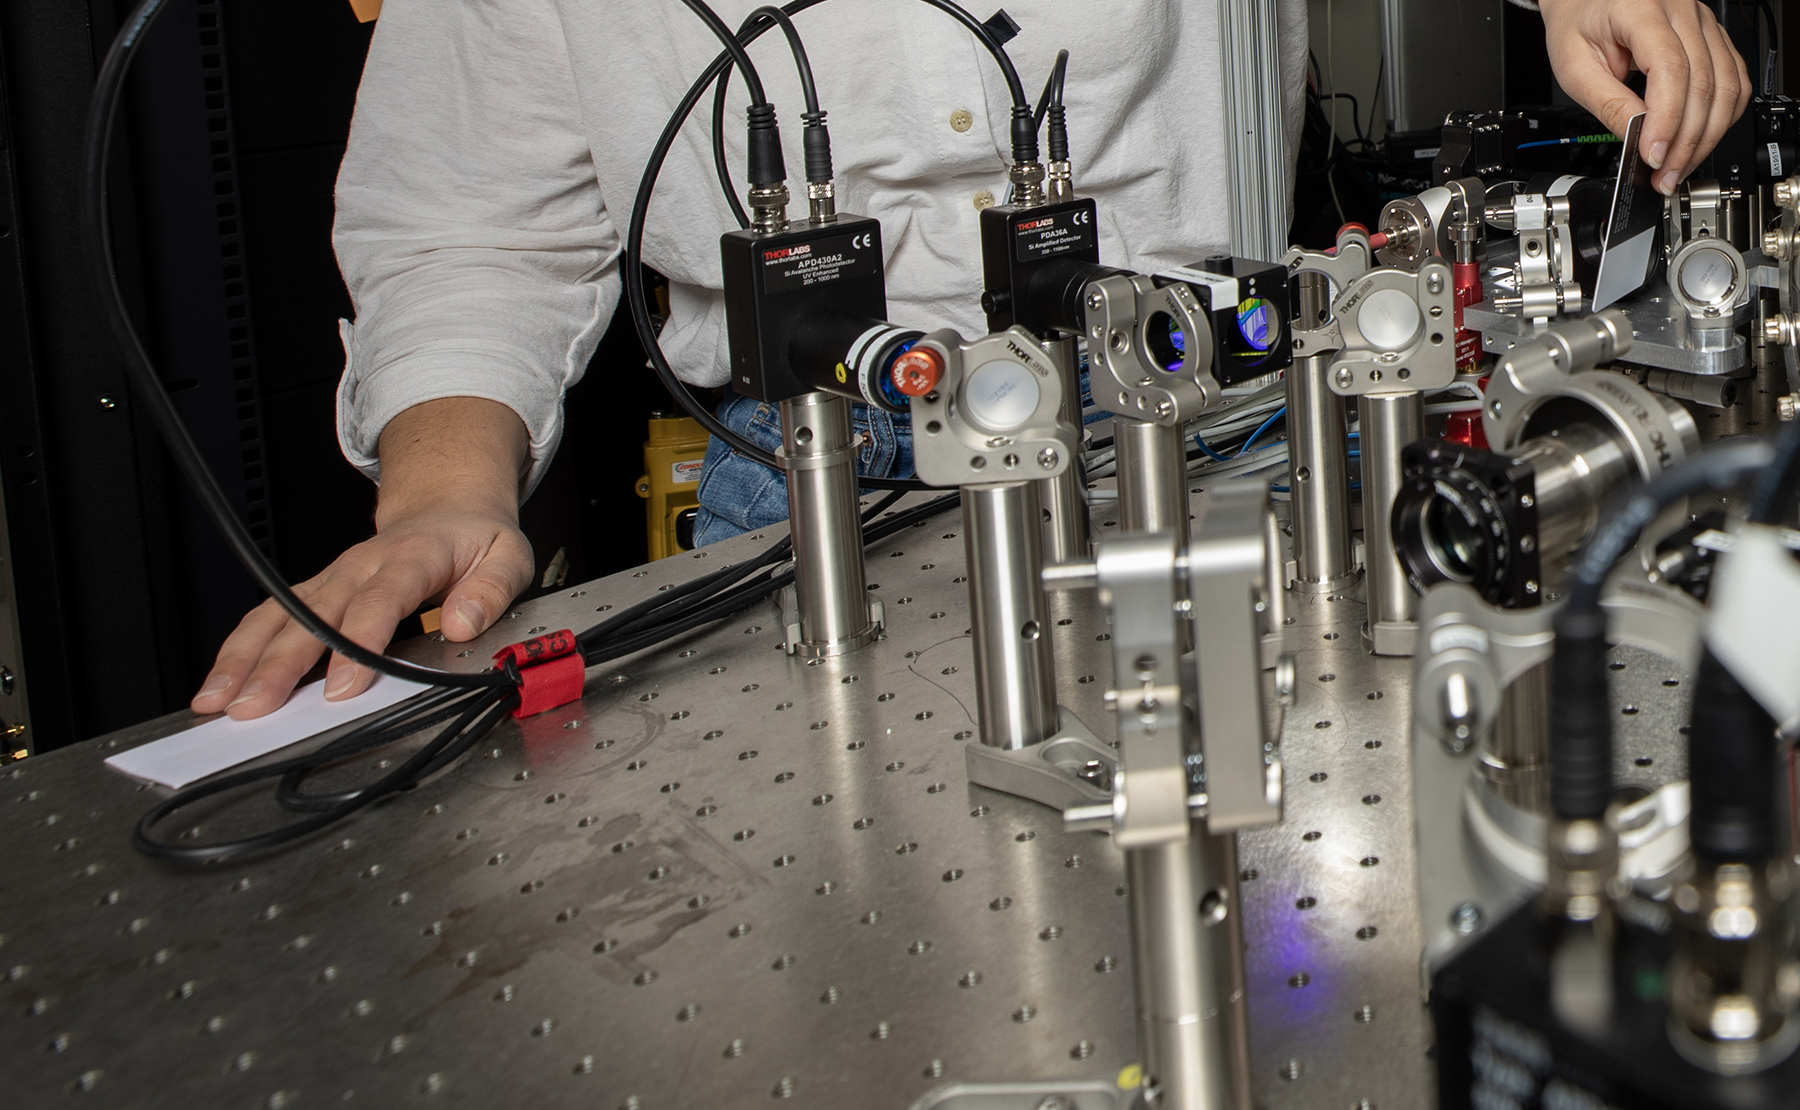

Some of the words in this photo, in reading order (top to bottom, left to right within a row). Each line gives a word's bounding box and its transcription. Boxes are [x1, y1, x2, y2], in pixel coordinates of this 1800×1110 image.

[1769, 144, 1781, 176] LA1951-B
[1017, 218, 1054, 231] THORLABS
[1040, 228, 1068, 239] PDA36A
[1035, 239, 1059, 249] Amplified
[1060, 235, 1081, 244] Detector
[764, 245, 811, 260] THORLABS
[765, 253, 812, 266] www.thorlabs.com
[791, 266, 819, 276] Avalanche
[820, 258, 856, 269] Photodetector
[798, 254, 843, 269] APD430A2
[813, 267, 839, 277] Enhanced
[818, 274, 831, 282] 1000
[1339, 279, 1375, 314] THORLABS
[1006, 340, 1049, 378] THORLABS
[894, 357, 930, 388] THORLABS
